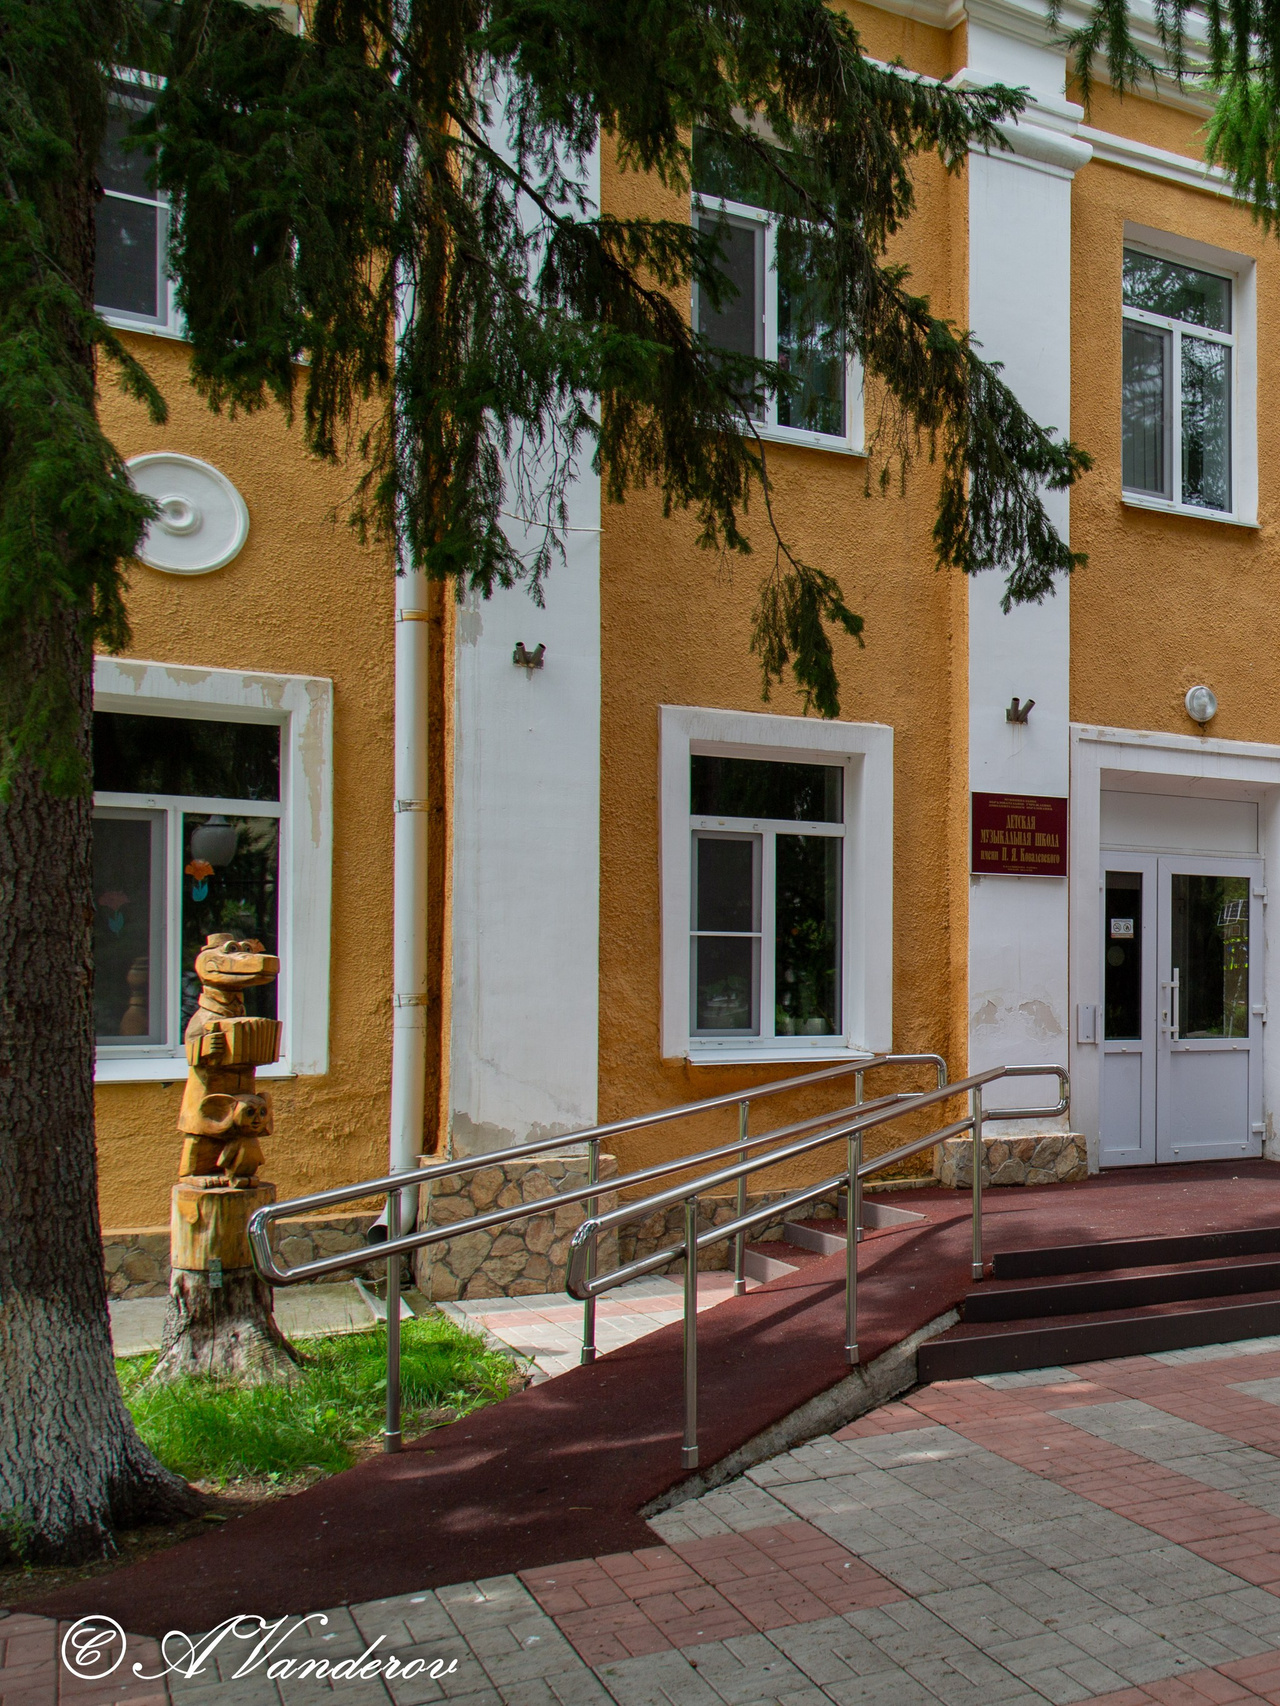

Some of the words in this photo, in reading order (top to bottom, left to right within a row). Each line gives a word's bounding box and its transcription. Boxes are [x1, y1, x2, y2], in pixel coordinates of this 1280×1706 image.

[1005, 814, 1036, 830] ДЕТСКАЯ
[980, 829, 1032, 846] МУЗЫКАЛЬНАЯ
[1035, 833, 1059, 847] ШКОЛА
[980, 850, 999, 860] имени
[1011, 848, 1018, 861] Я.
[1020, 848, 1060, 863] Ковалевского
